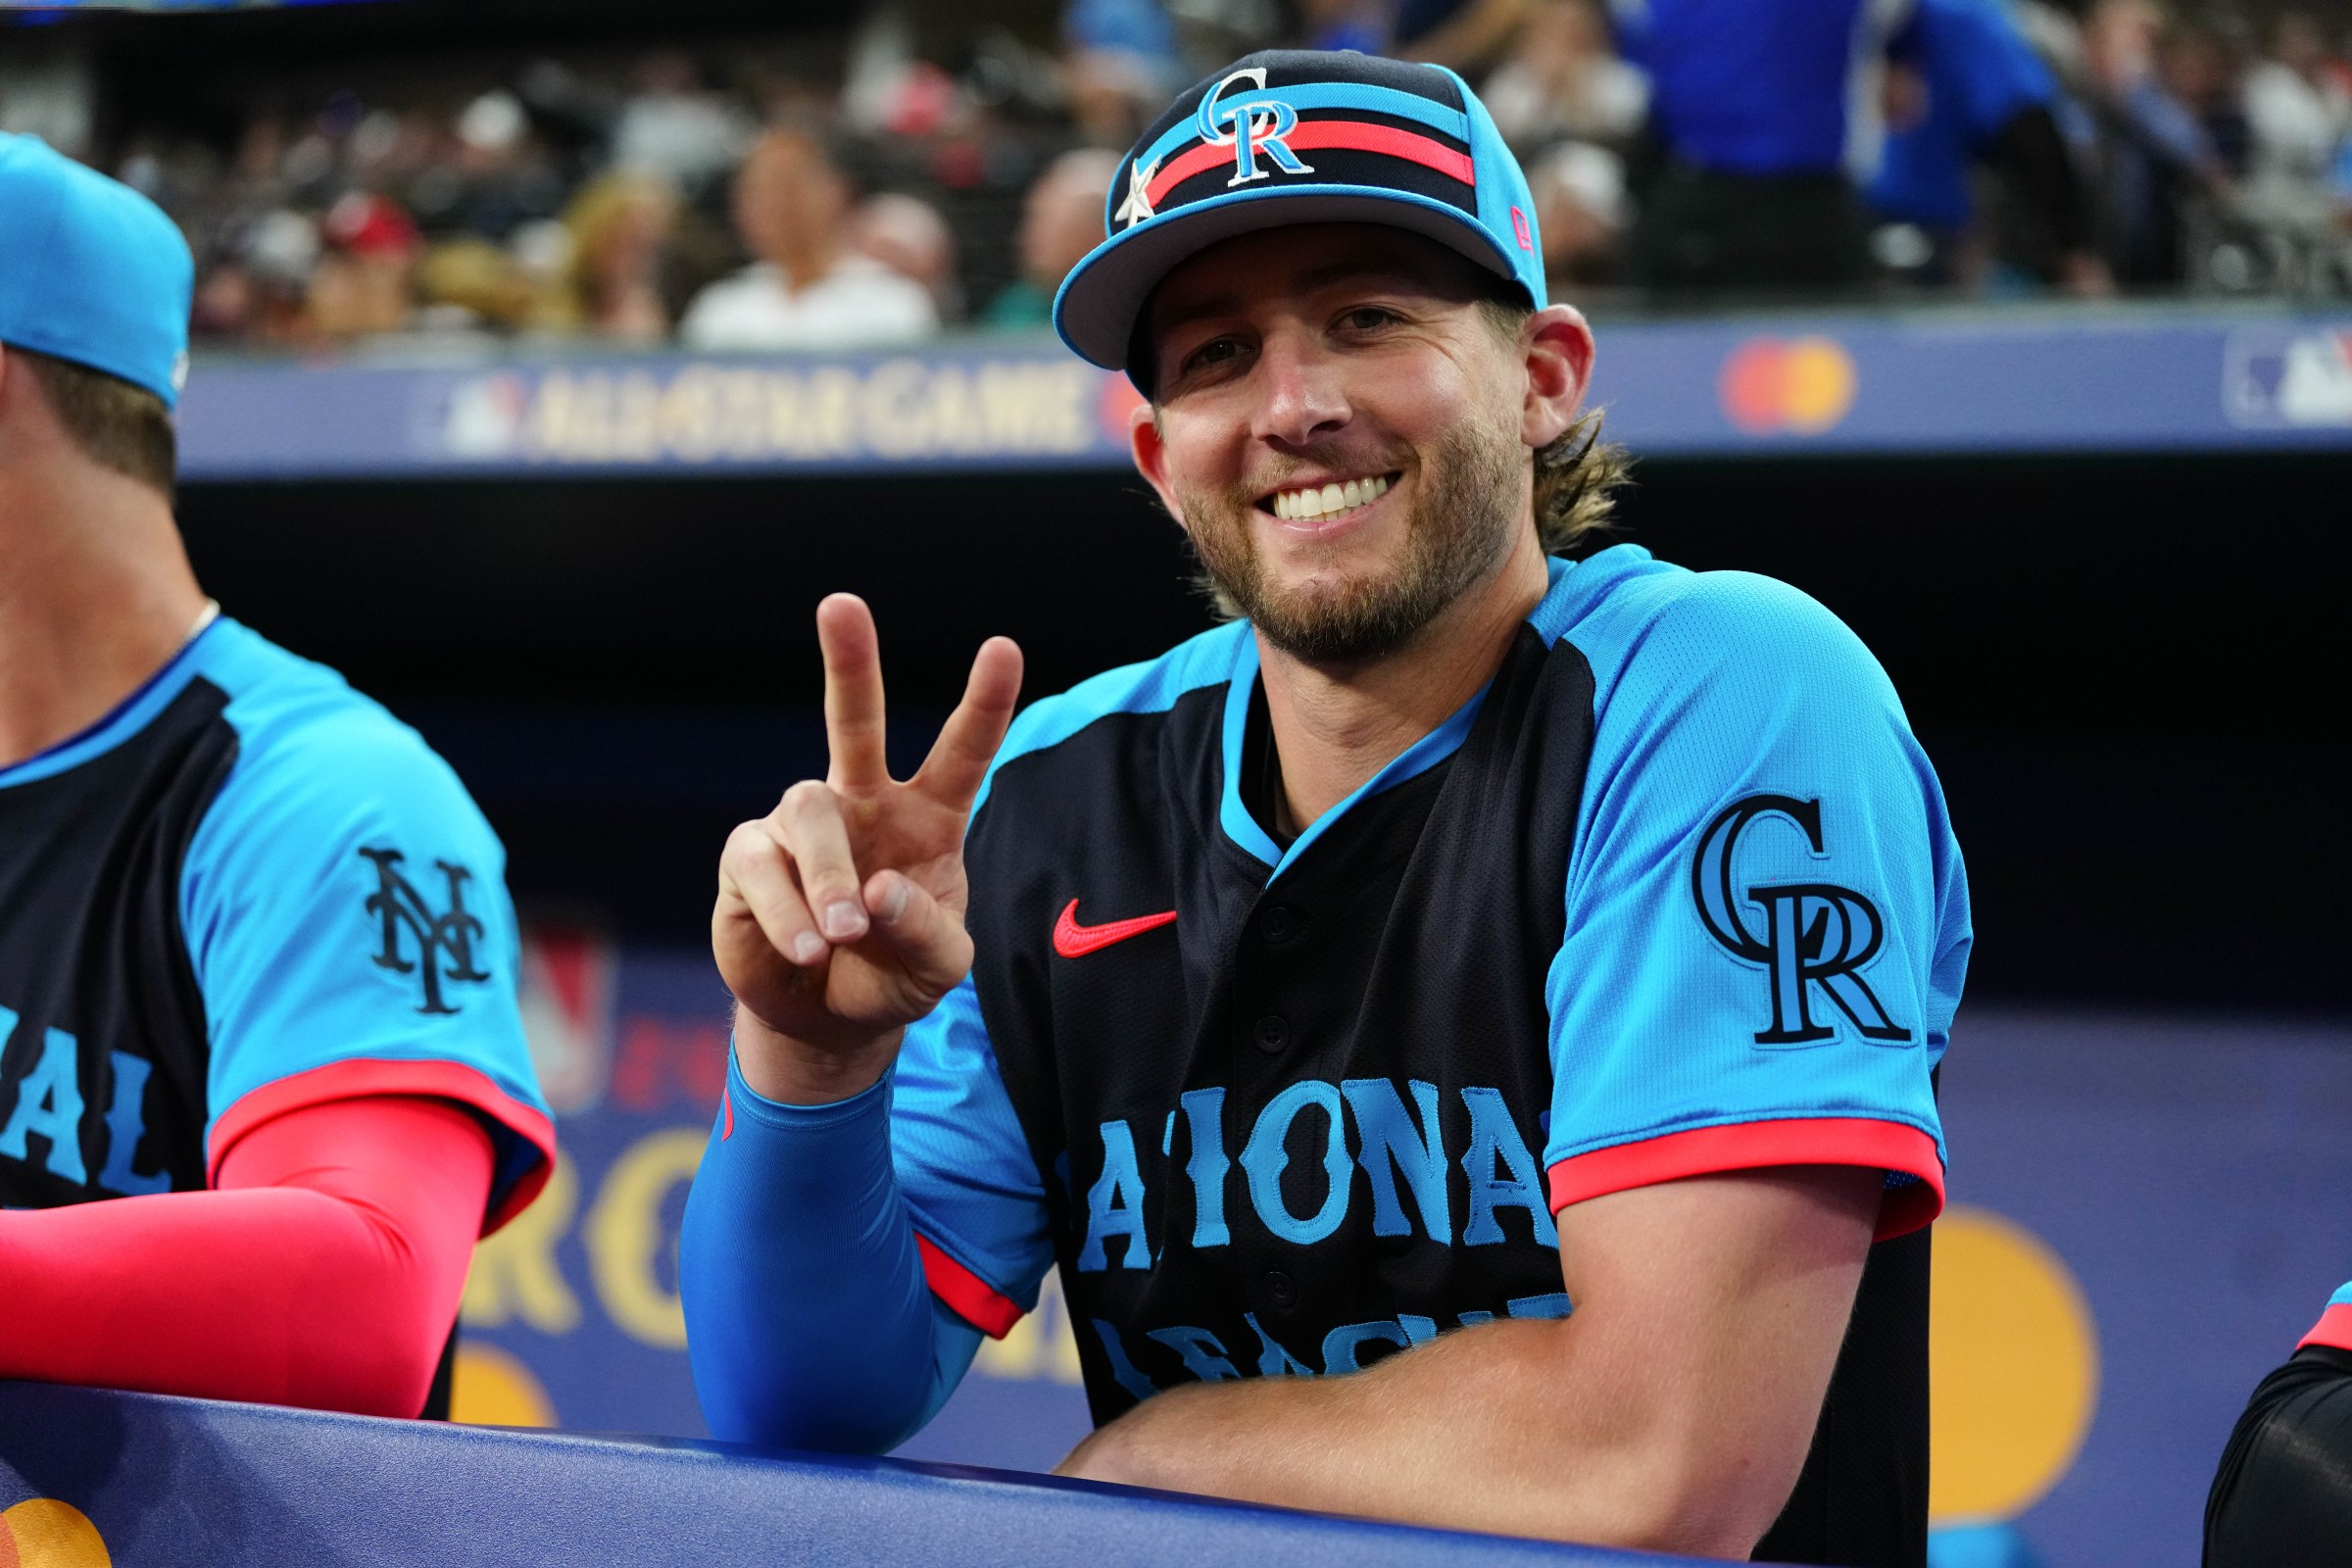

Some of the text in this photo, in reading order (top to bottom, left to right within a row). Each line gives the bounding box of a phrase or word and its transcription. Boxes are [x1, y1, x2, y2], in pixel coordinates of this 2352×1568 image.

[1197, 67, 1314, 187] CR
[358, 846, 491, 1014] NY
[1690, 792, 1912, 1045] CR
[1060, 1077, 1560, 1272] AIONA
